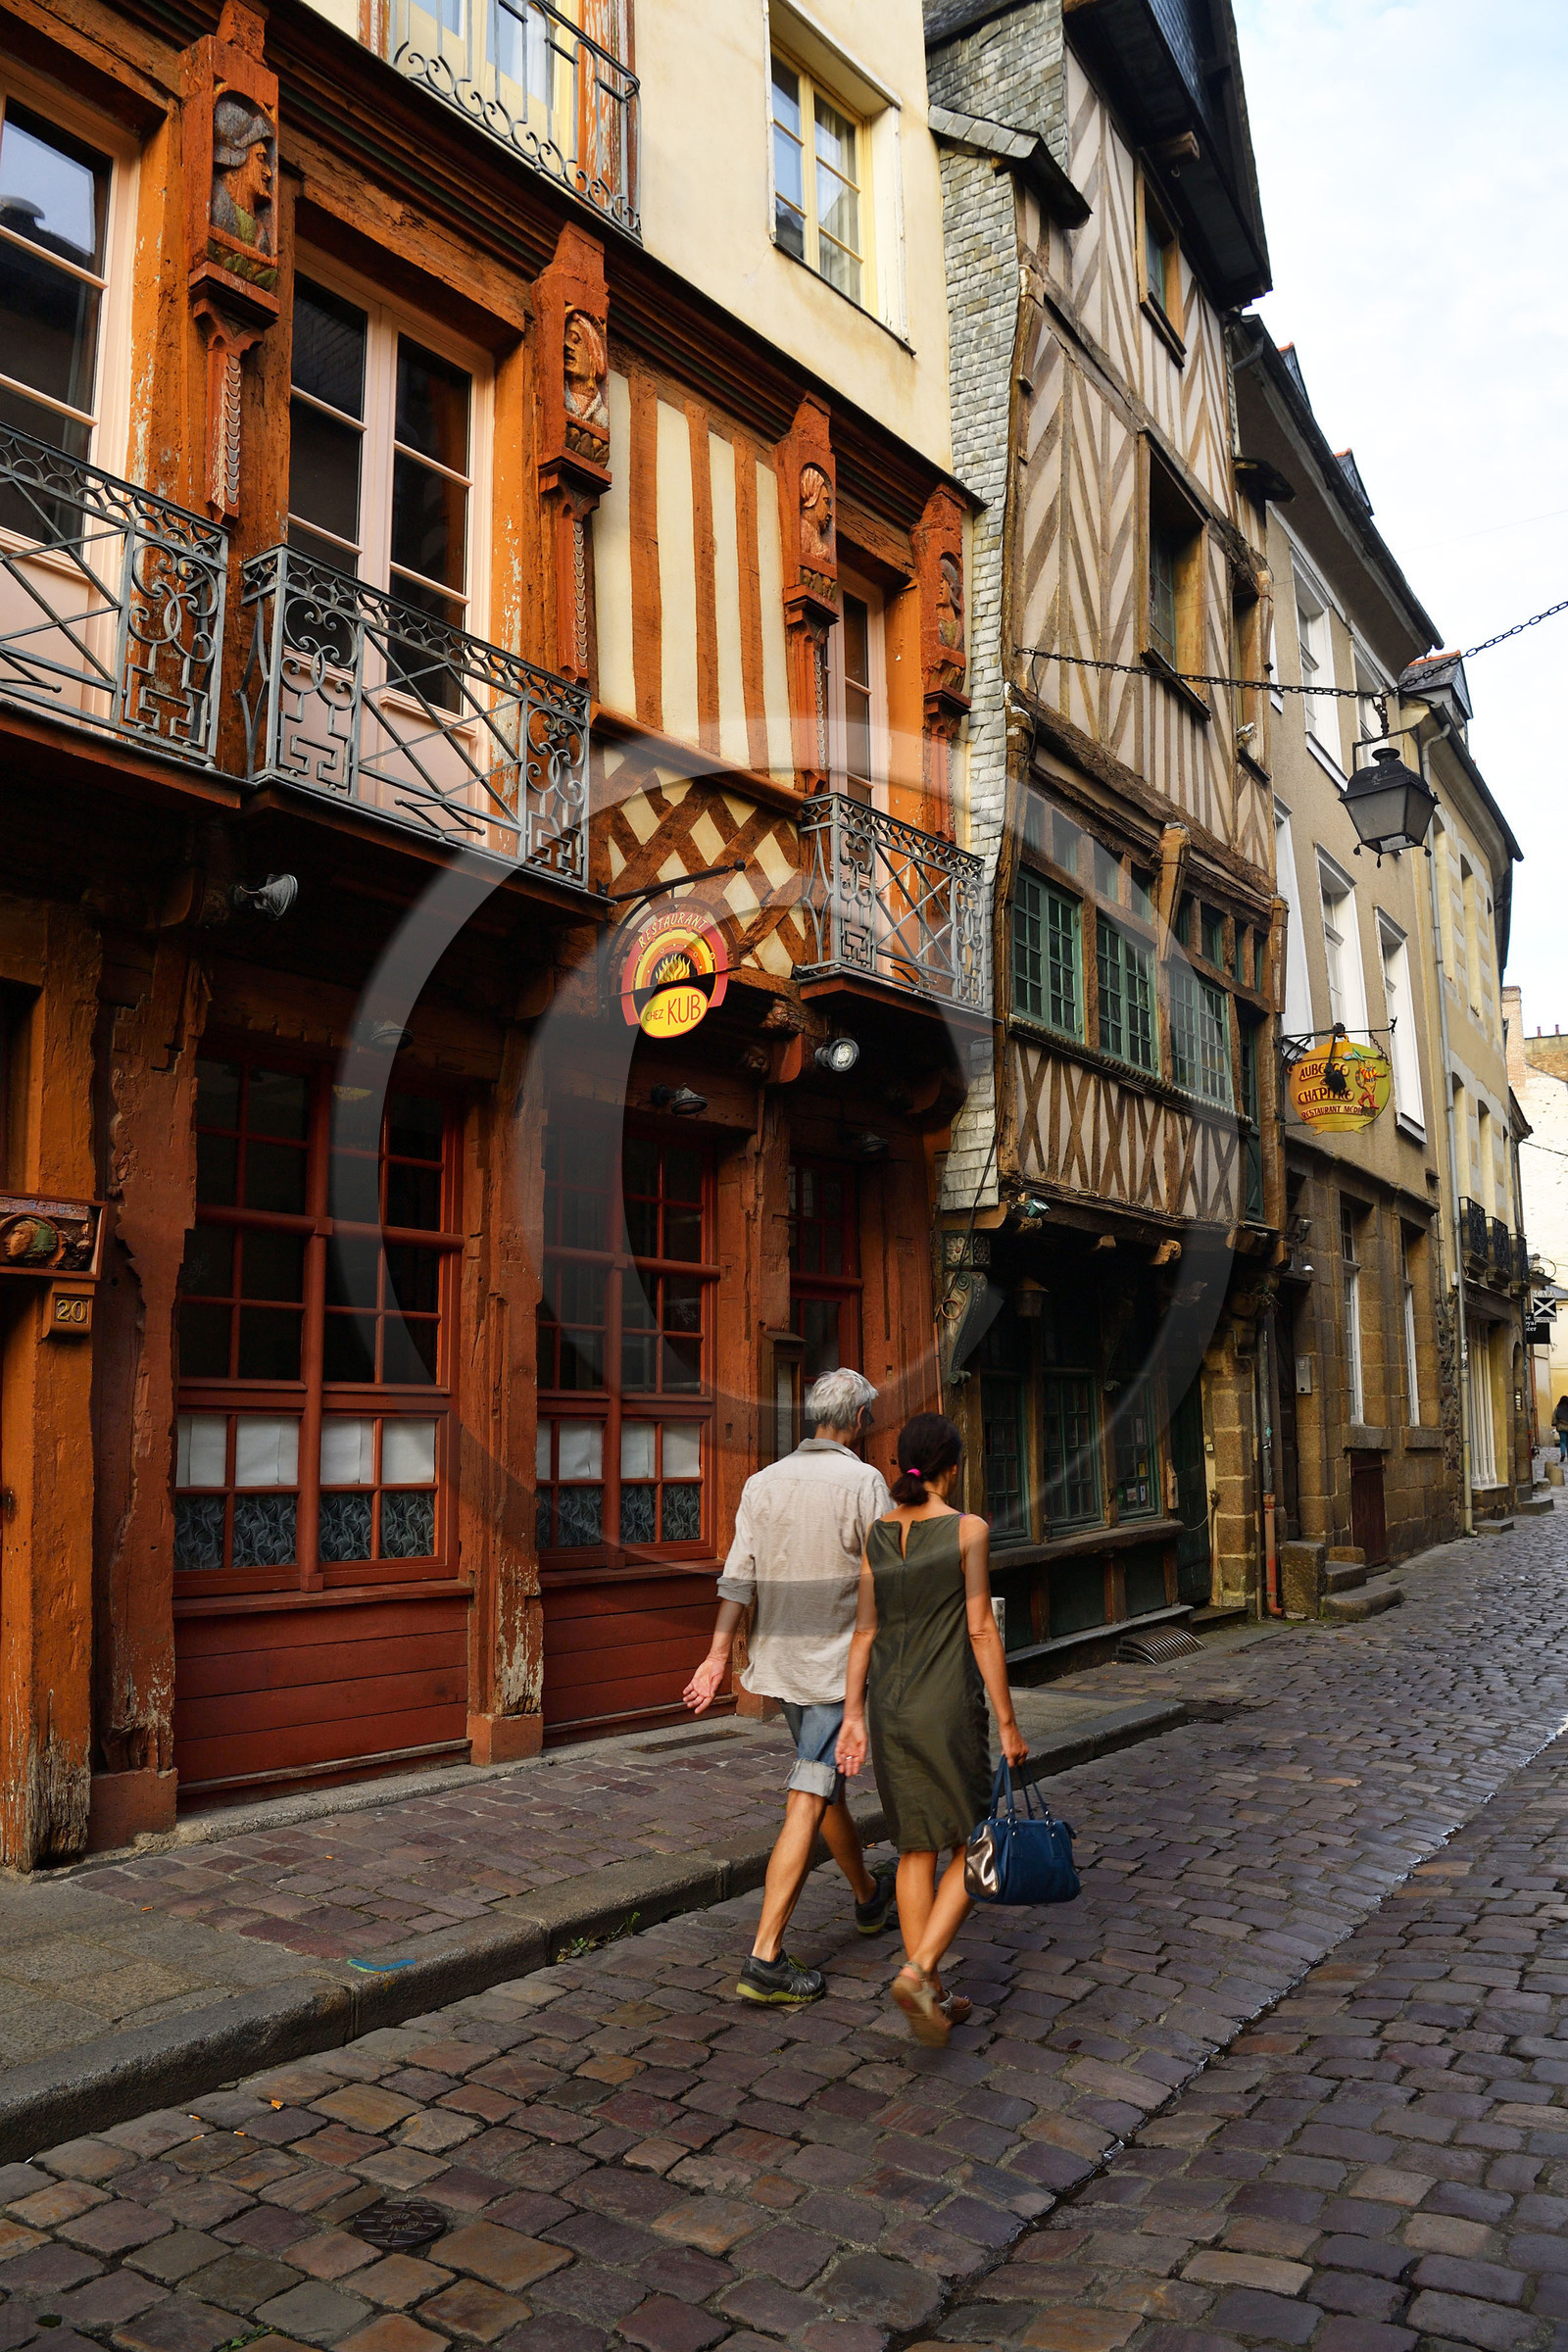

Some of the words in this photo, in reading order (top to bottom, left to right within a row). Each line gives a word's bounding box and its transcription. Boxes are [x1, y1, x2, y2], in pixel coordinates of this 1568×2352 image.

[638, 911, 709, 949] RESTAURANT
[645, 1008, 663, 1022] CHEZ
[667, 994, 702, 1026] KUB
[1300, 1104, 1342, 1119] RESTAURANT
[56, 1298, 87, 1323] 20
